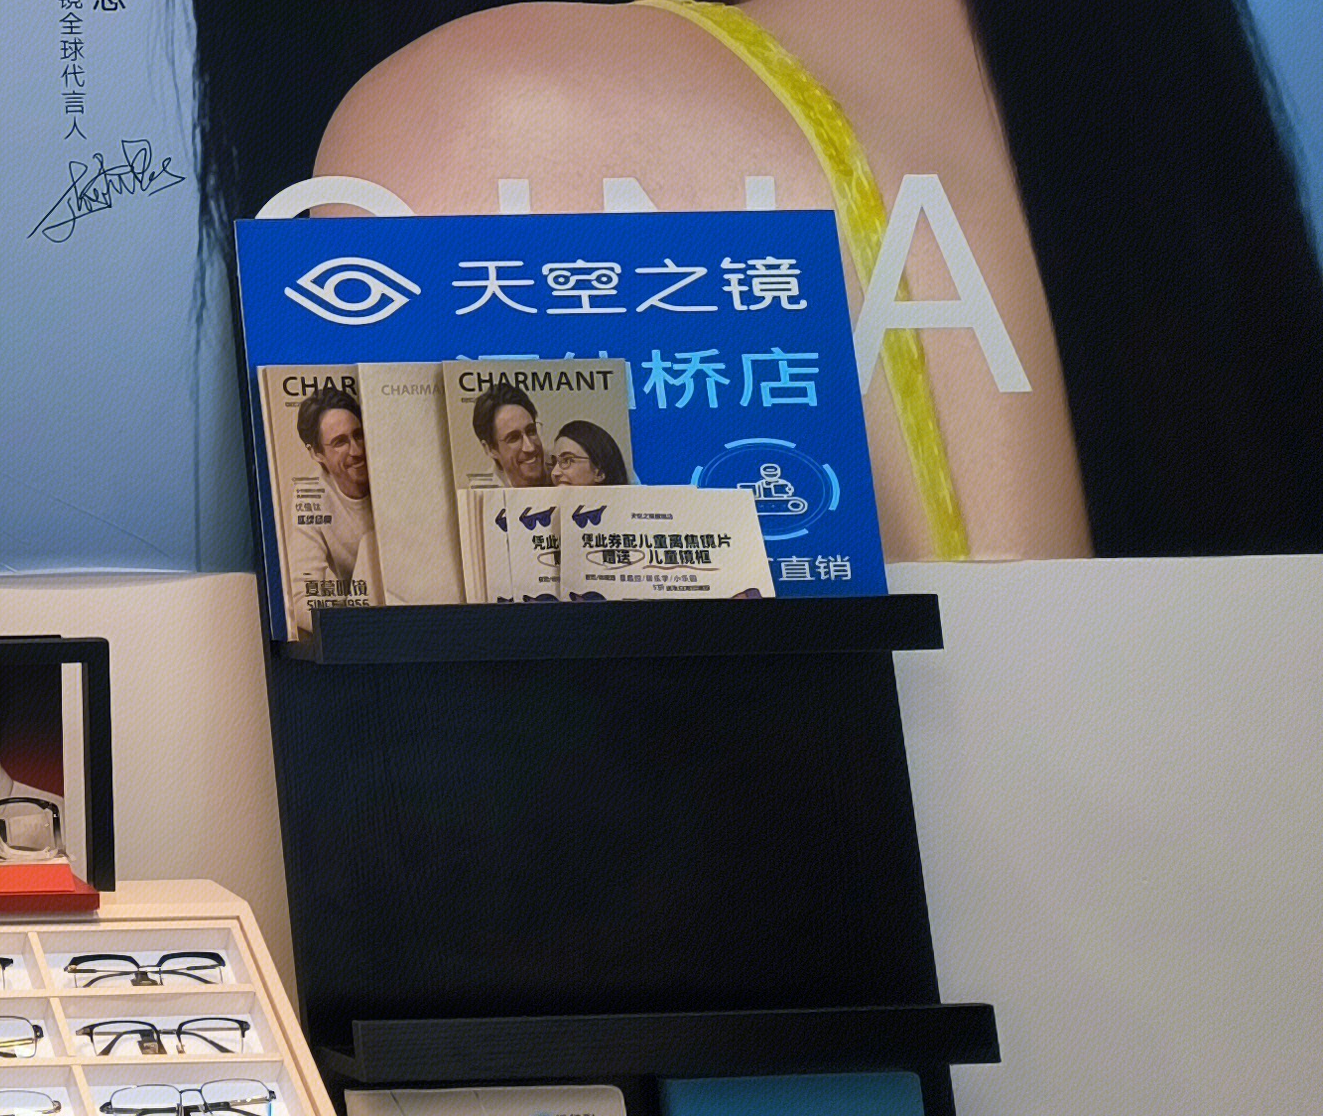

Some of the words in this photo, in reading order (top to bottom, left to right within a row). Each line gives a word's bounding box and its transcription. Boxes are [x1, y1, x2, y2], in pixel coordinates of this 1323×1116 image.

[452, 257, 808, 316] 天空之镜
[458, 370, 615, 393] CHARMANT
[768, 554, 852, 581] 直销
